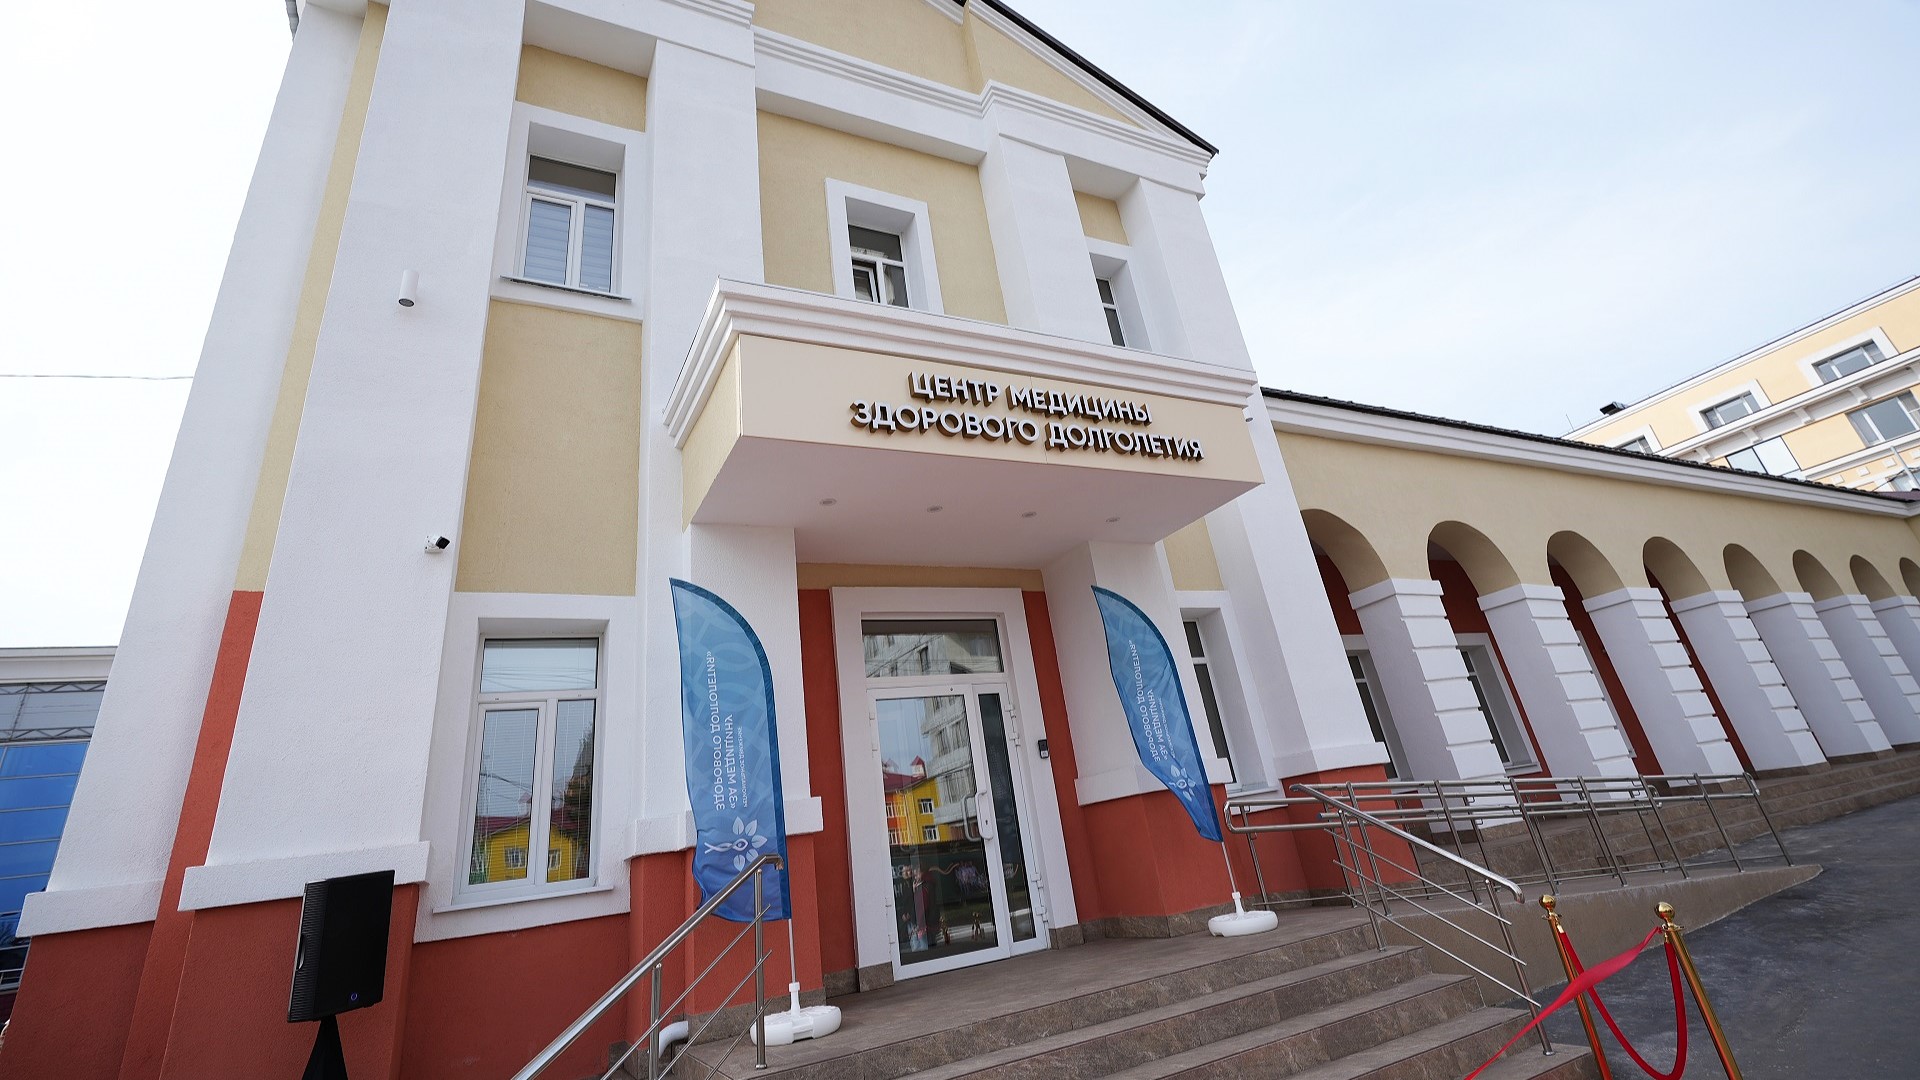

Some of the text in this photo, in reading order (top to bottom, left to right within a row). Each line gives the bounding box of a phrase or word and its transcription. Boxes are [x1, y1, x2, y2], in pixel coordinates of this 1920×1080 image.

[909, 371, 1153, 424] ЦЕНТР МЕДИЦИНЫ
[850, 401, 1205, 461] ЗДОРОВОГО ДОЛГОЛЕТИЯ
